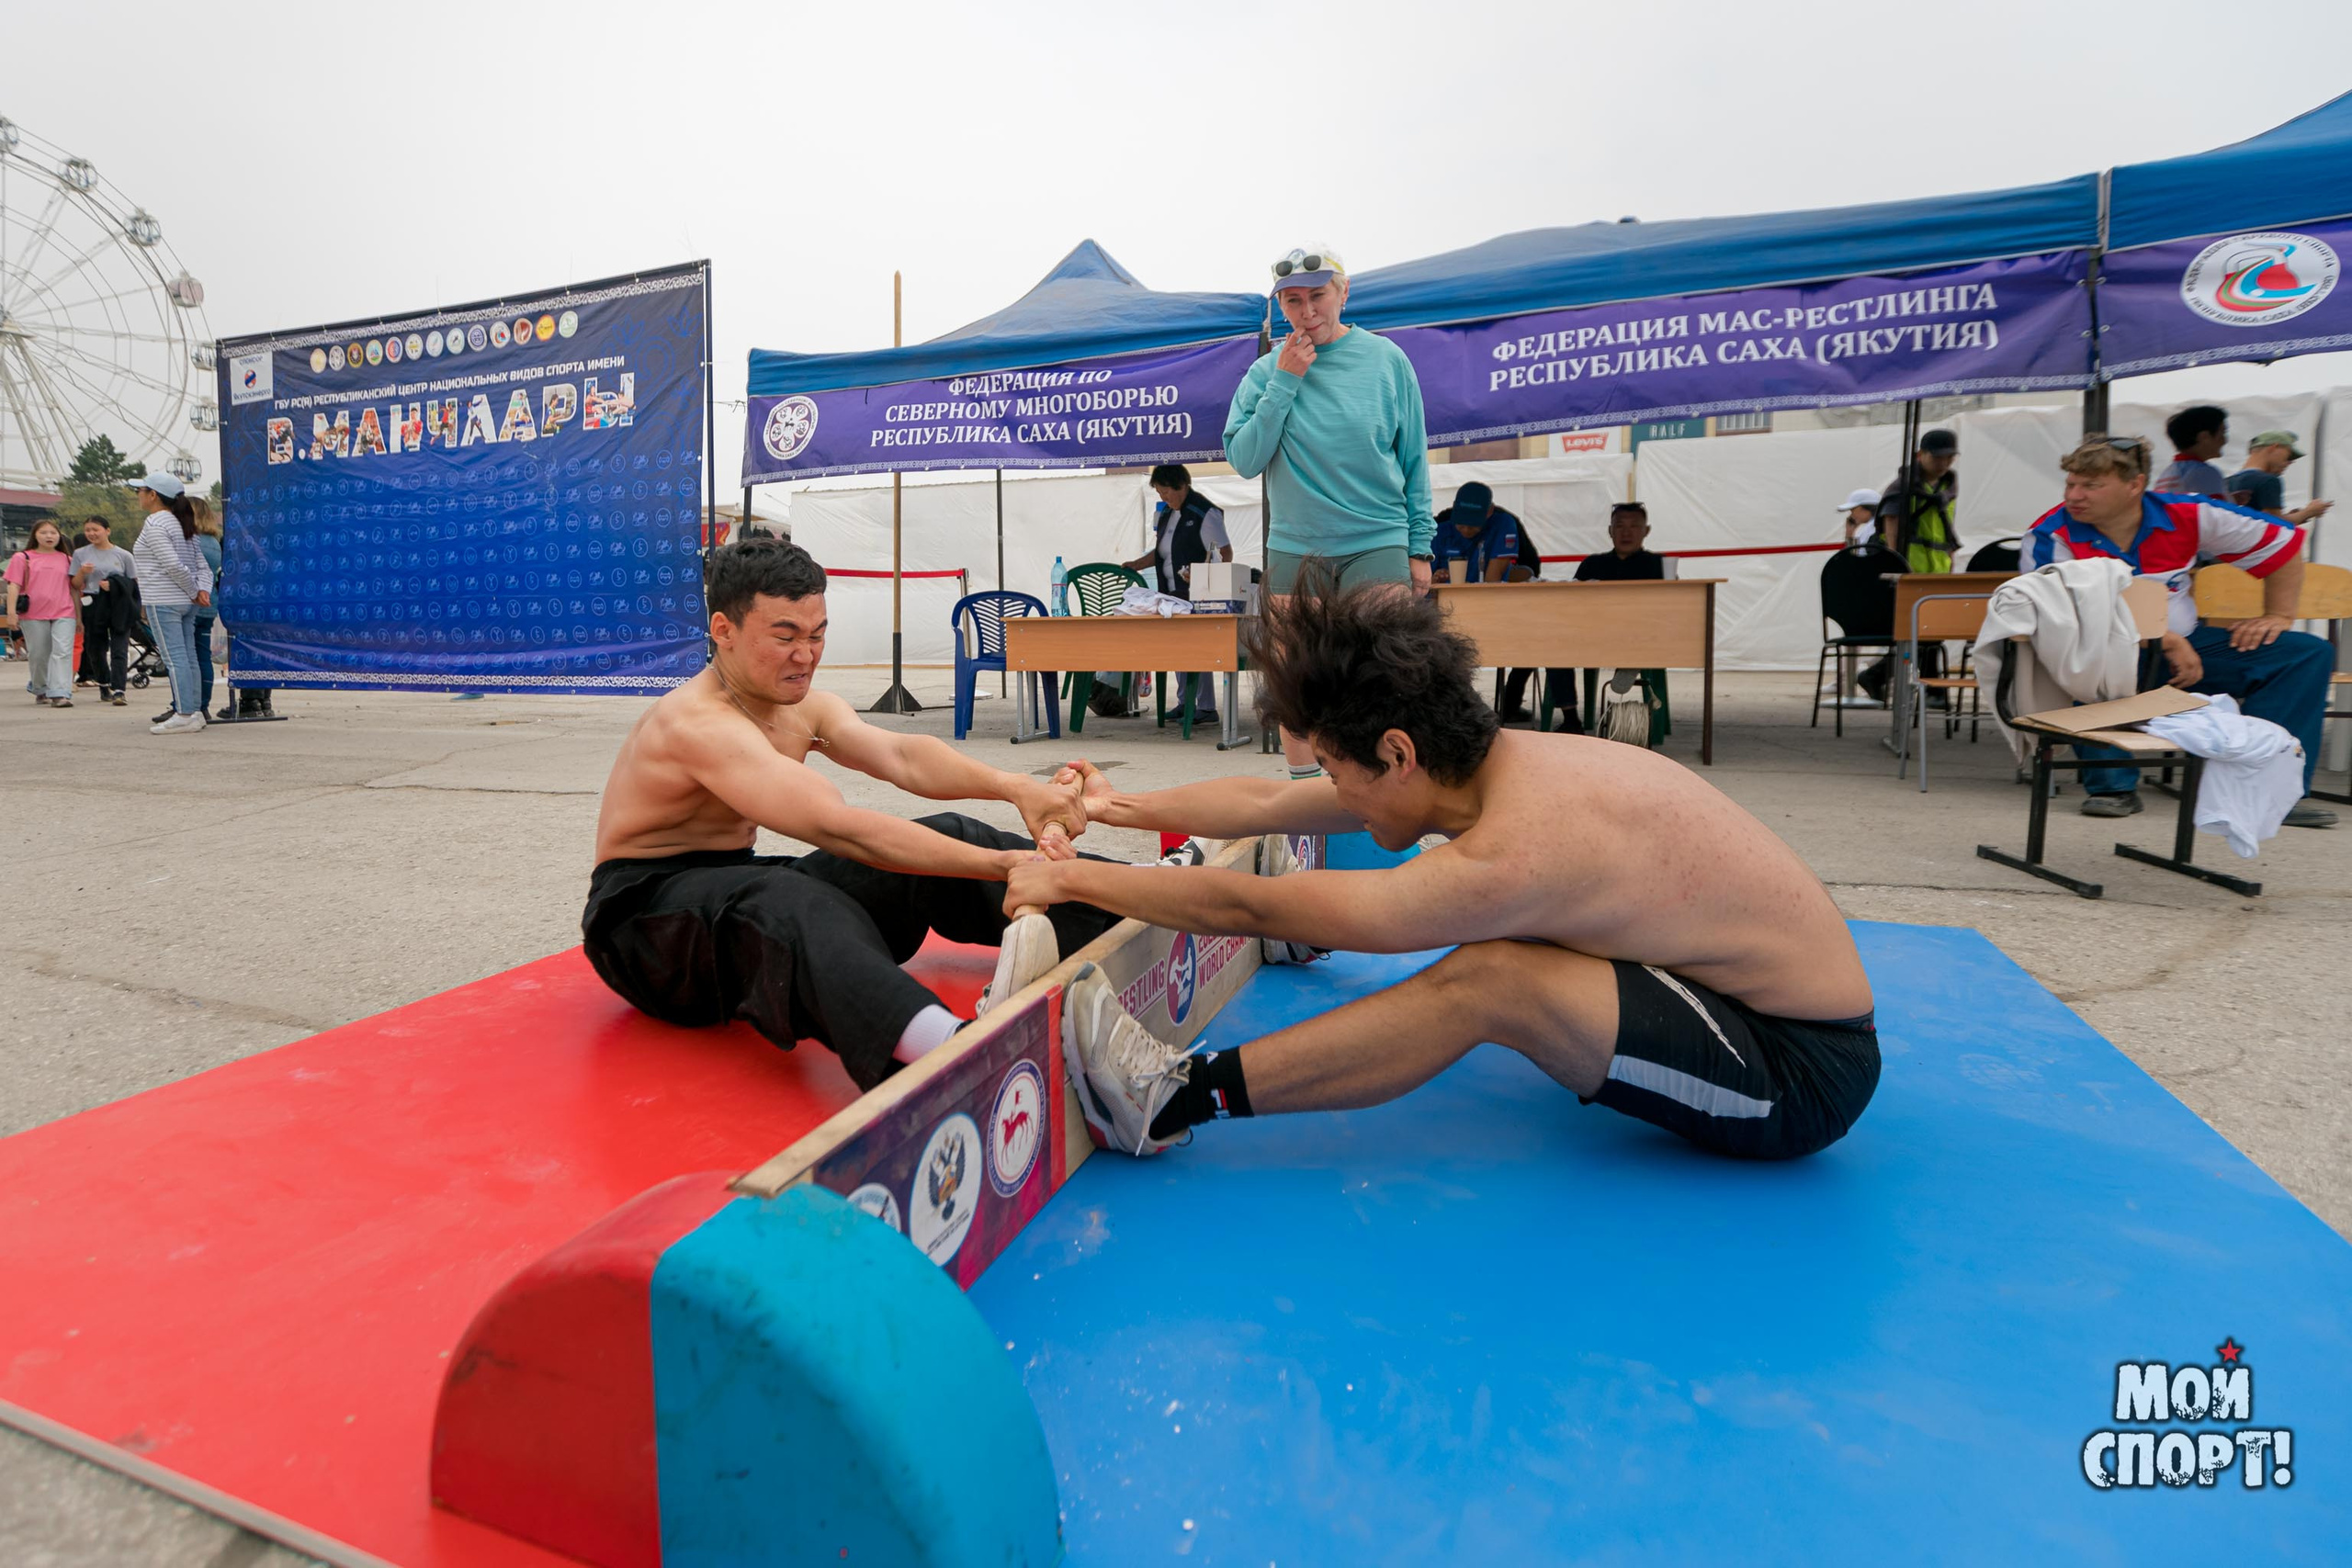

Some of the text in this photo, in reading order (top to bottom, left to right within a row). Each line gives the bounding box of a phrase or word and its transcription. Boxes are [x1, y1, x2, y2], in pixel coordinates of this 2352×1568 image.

[1492, 283, 1998, 362] ФЕДЕРАЦИЯ МАС-РЕСТЛИНГА
[1489, 320, 1999, 392] РЕСПУБЛИКА САХА (ЯКУТИЯ)
[275, 355, 626, 411] ГБУ РС(Я) РЕСПУБЛИКАНСКИЙ ЦЕНТР НАЦИОНАЛЬНЫХ ВИДОВ СПОРТА ИМЕНИ
[885, 385, 1179, 423] СЕВЕРНОМУ МНОГОБОРЬЮ
[948, 369, 1113, 398] ФЕДЕРАЦИЯ ПО
[870, 412, 1193, 447] РЕСПУБЛИКА САХА (ЯКУТИЯ)
[1198, 945, 1224, 989] WORLD
